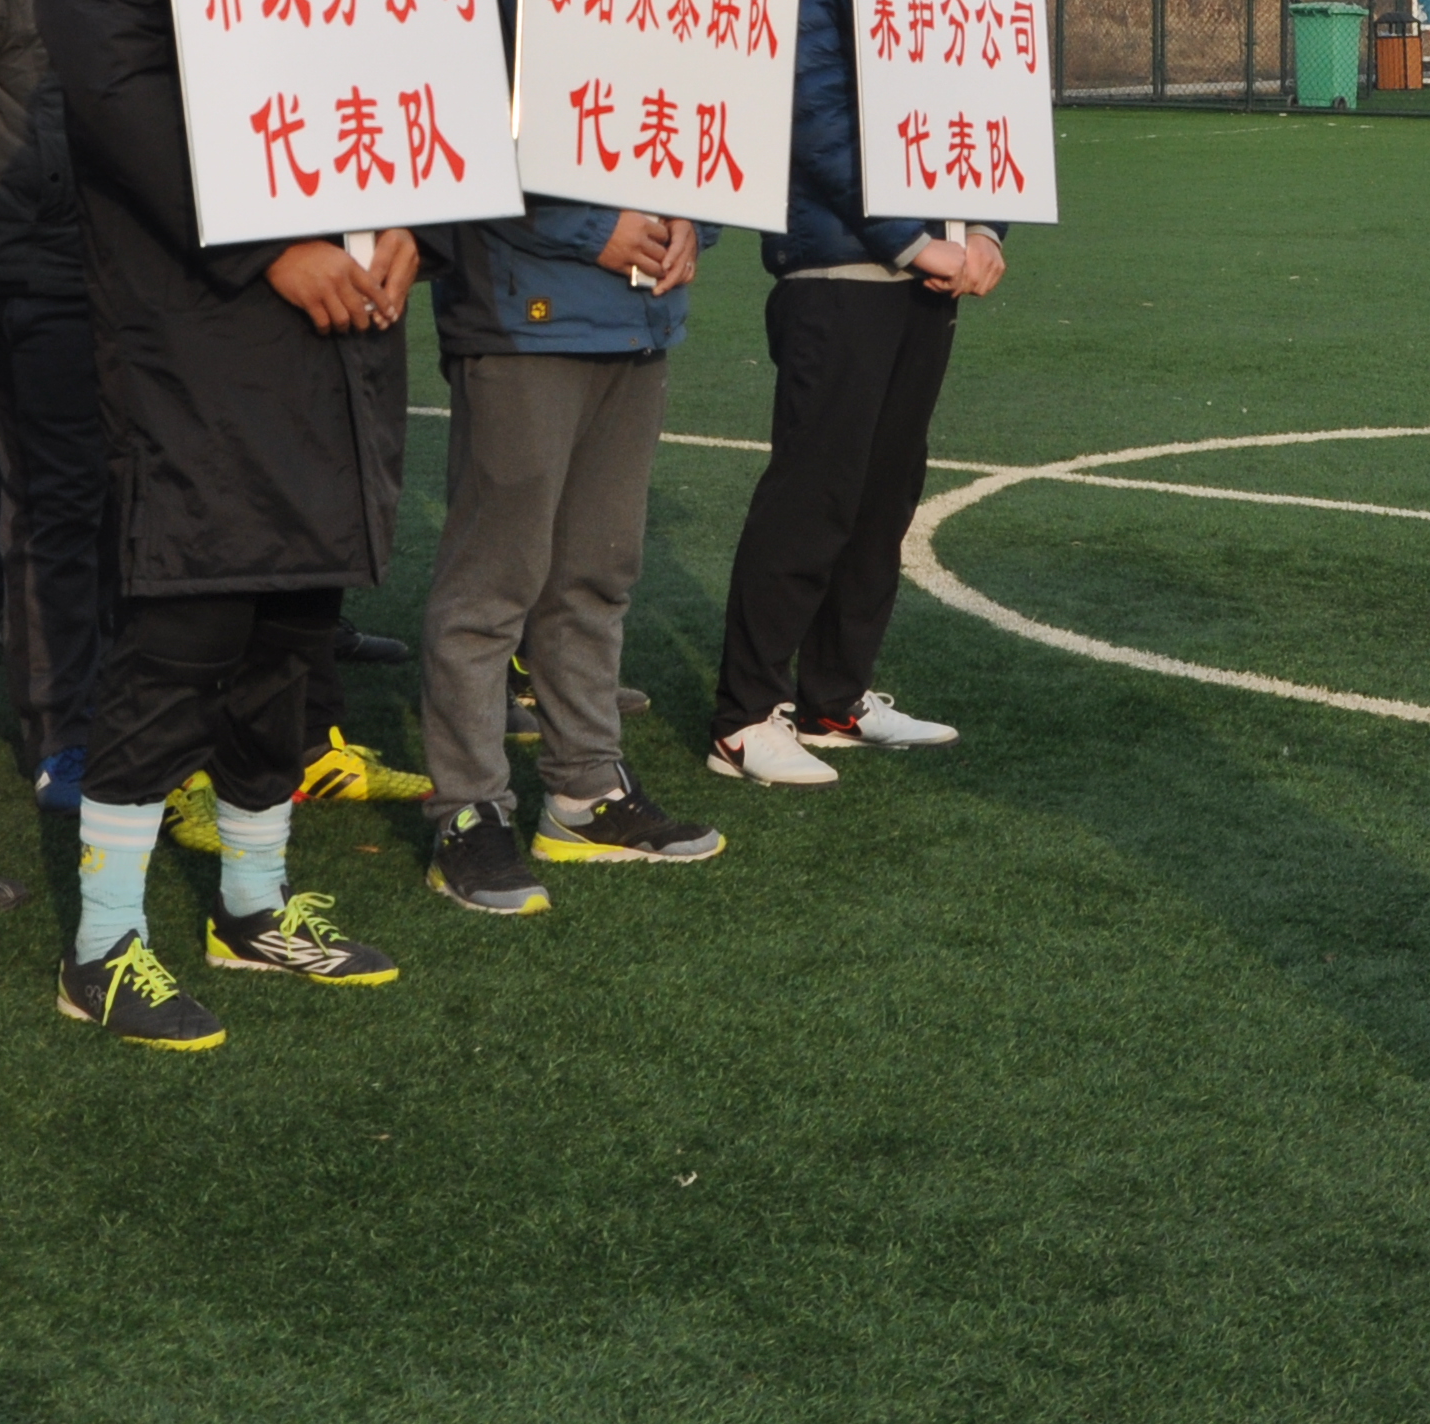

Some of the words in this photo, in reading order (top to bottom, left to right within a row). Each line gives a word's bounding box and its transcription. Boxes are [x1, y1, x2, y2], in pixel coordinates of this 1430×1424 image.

[249, 82, 466, 199] 代表队
[568, 77, 745, 193] 代表队
[897, 109, 1025, 194] 代表队
